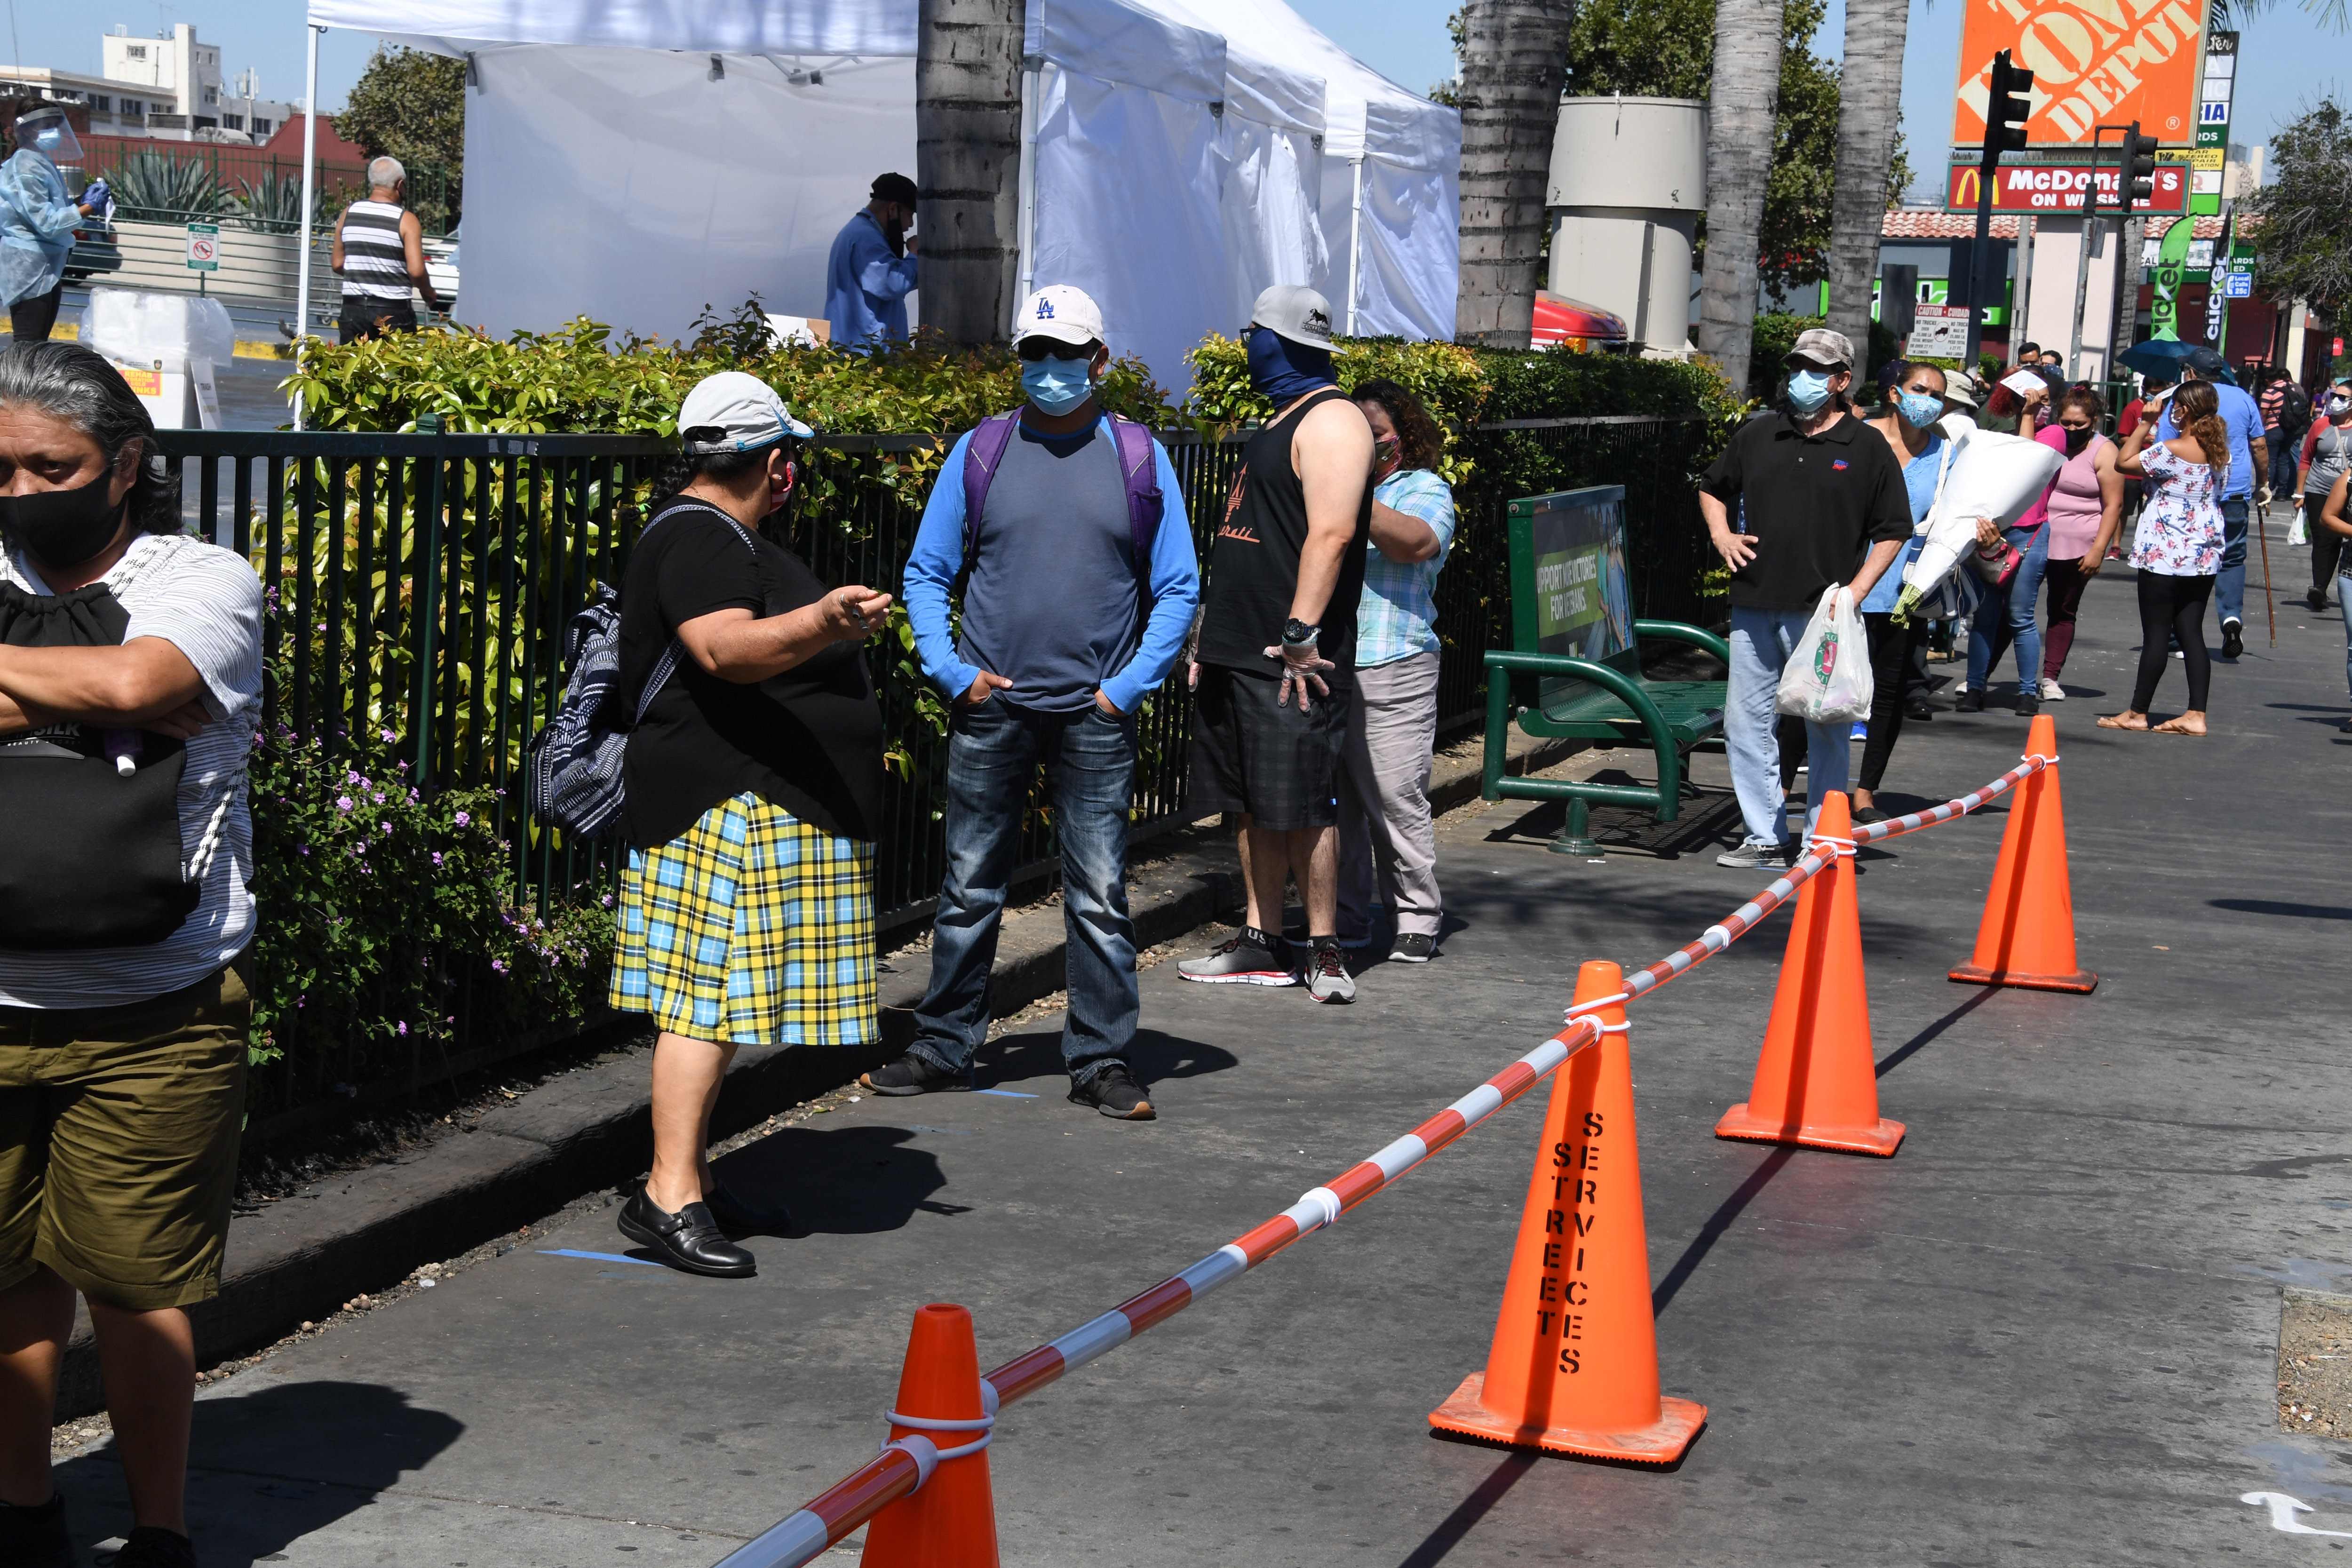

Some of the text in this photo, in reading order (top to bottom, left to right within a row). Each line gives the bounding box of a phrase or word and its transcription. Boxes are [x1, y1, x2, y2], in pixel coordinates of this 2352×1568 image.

[2046, 0, 2200, 142] DEPOT
[2008, 170, 2177, 191] McDon's
[2031, 194, 2057, 207] ON
[1036, 297, 1055, 319] LA
[2153, 258, 2181, 333] ricket
[1918, 306, 1942, 316] CAUTION
[133, 386, 156, 395] INKS
[1572, 554, 1597, 584] VICTORIES
[1550, 594, 1564, 621] FOR
[1537, 1142, 1572, 1335] STREET
[1559, 1112, 1604, 1374] SERVICES
